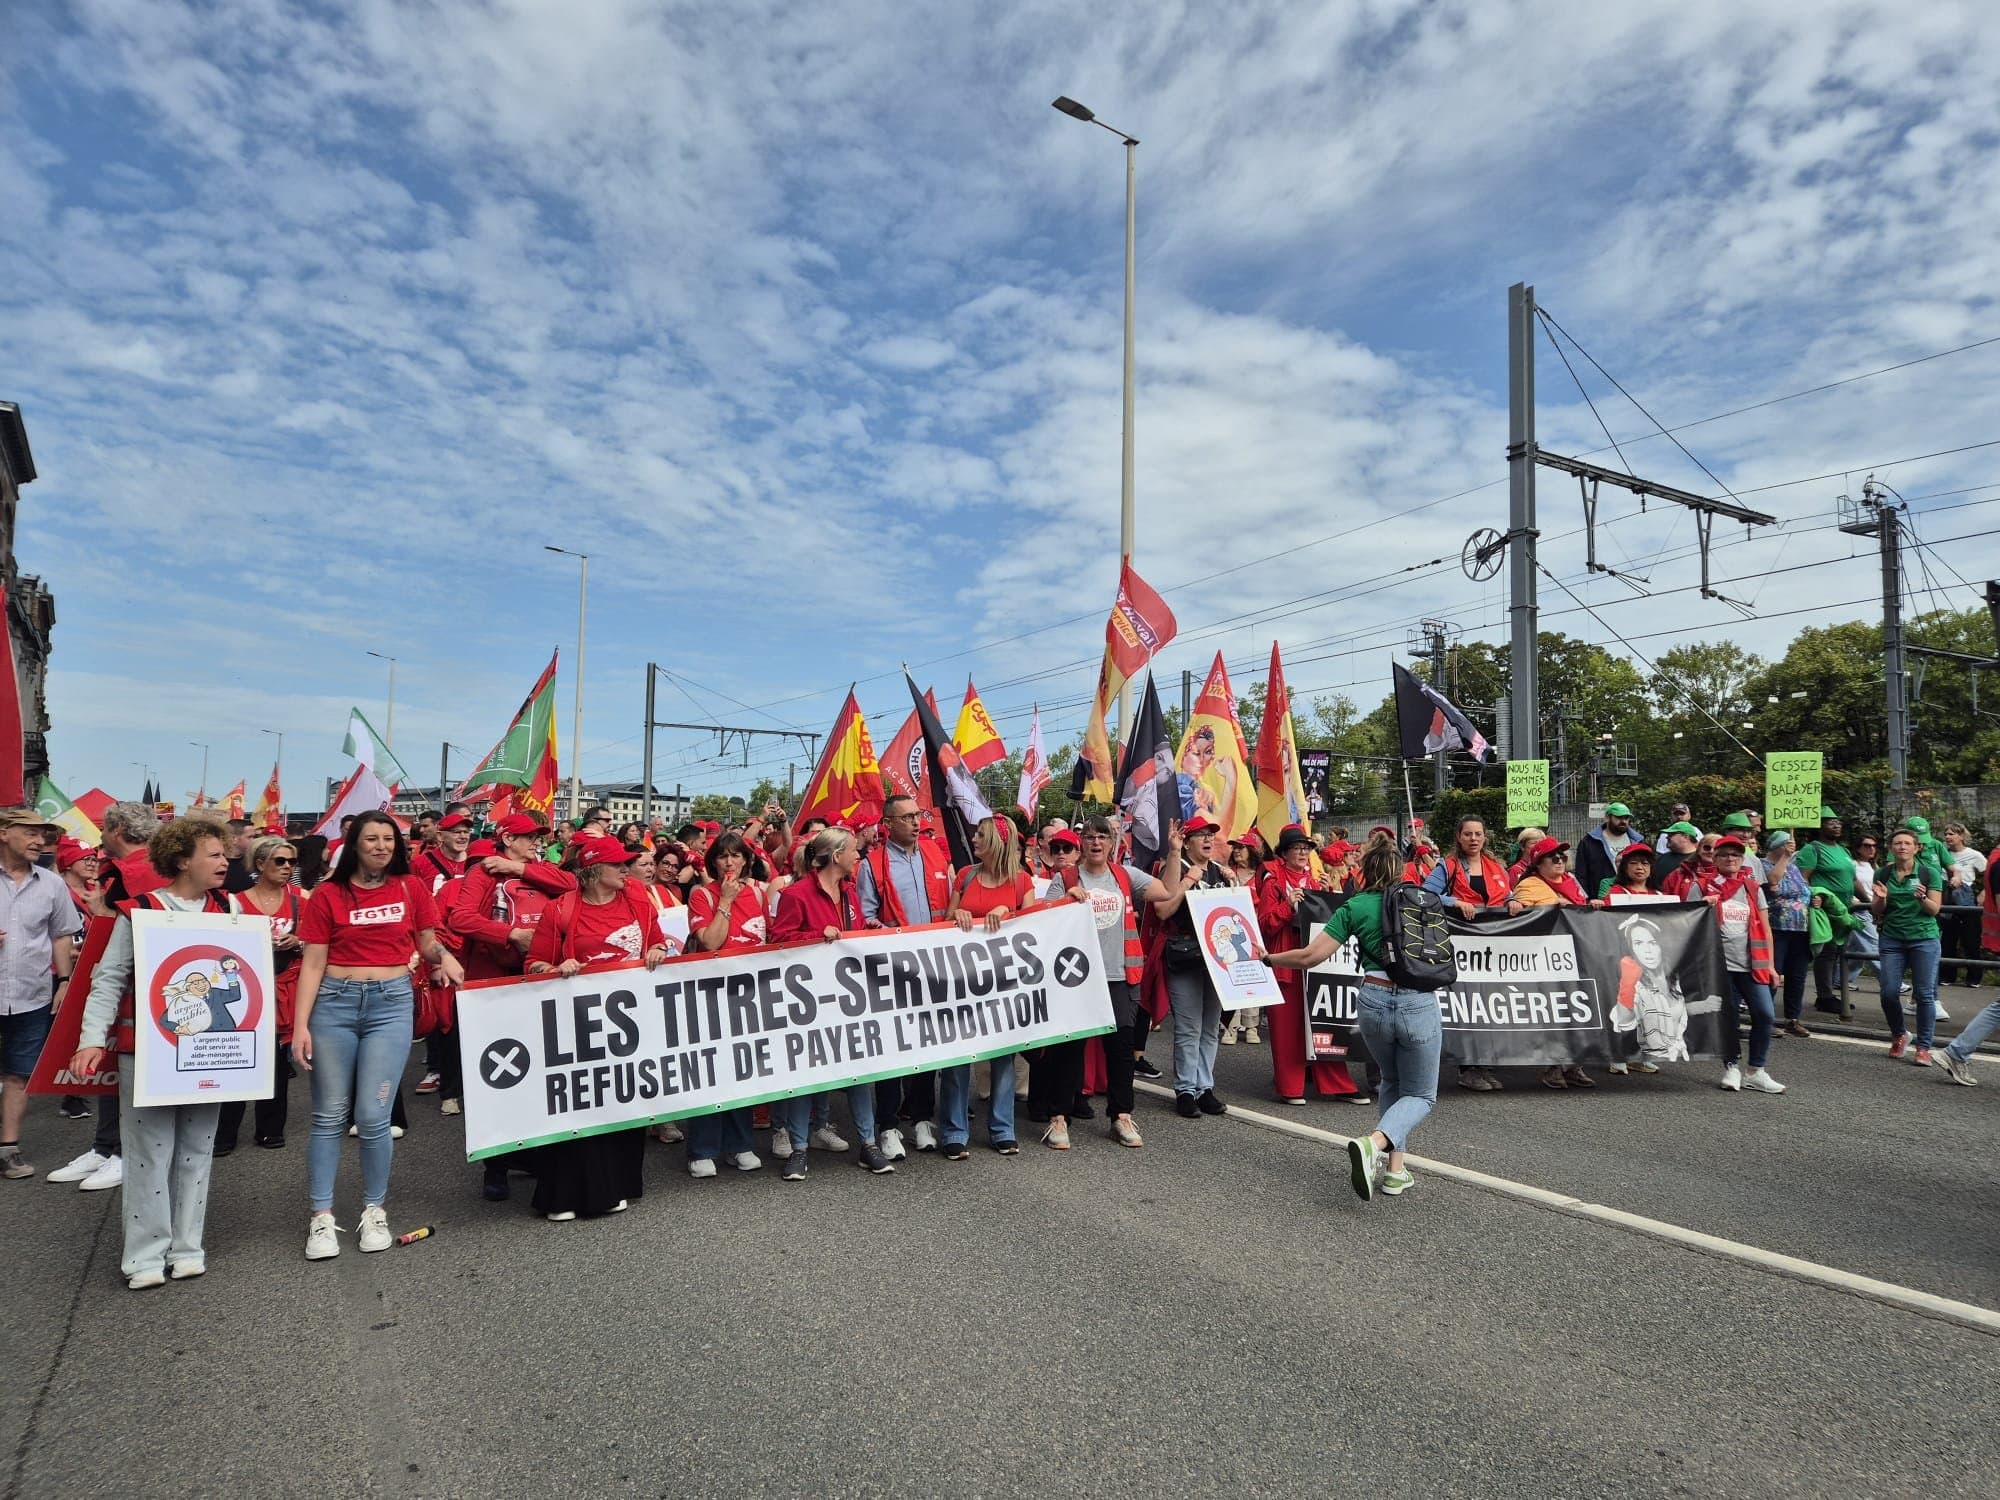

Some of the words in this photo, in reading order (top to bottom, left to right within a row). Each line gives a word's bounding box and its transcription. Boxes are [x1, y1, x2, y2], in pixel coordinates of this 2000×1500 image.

[910, 746, 922, 782] CHEM
[1507, 763, 1530, 774] NOUS
[1533, 763, 1545, 774] NE
[1771, 760, 1818, 772] CESSEZ
[1510, 775, 1545, 785] SOMMES
[1509, 788, 1523, 797] PAS
[1526, 788, 1542, 797] VOS
[1771, 782, 1821, 797] BALAYER
[1507, 801, 1549, 813] TORCHONS
[1785, 798, 1804, 806] NOS
[1773, 806, 1820, 820] DROITS
[353, 906, 401, 920] FGTB
[1456, 946, 1492, 972] ent
[1498, 951, 1538, 977] pour
[1544, 946, 1574, 972] les
[541, 989, 640, 1068] LES
[655, 932, 1045, 1048] TITRES-SERVICES
[1312, 984, 1360, 1019] AID
[1436, 985, 1593, 1025] ÉNAGÈRES
[546, 1047, 717, 1116] REFUSENT
[732, 1038, 774, 1082] DE
[785, 1019, 883, 1072] PAYER
[894, 988, 1049, 1052] L'ADDITION
